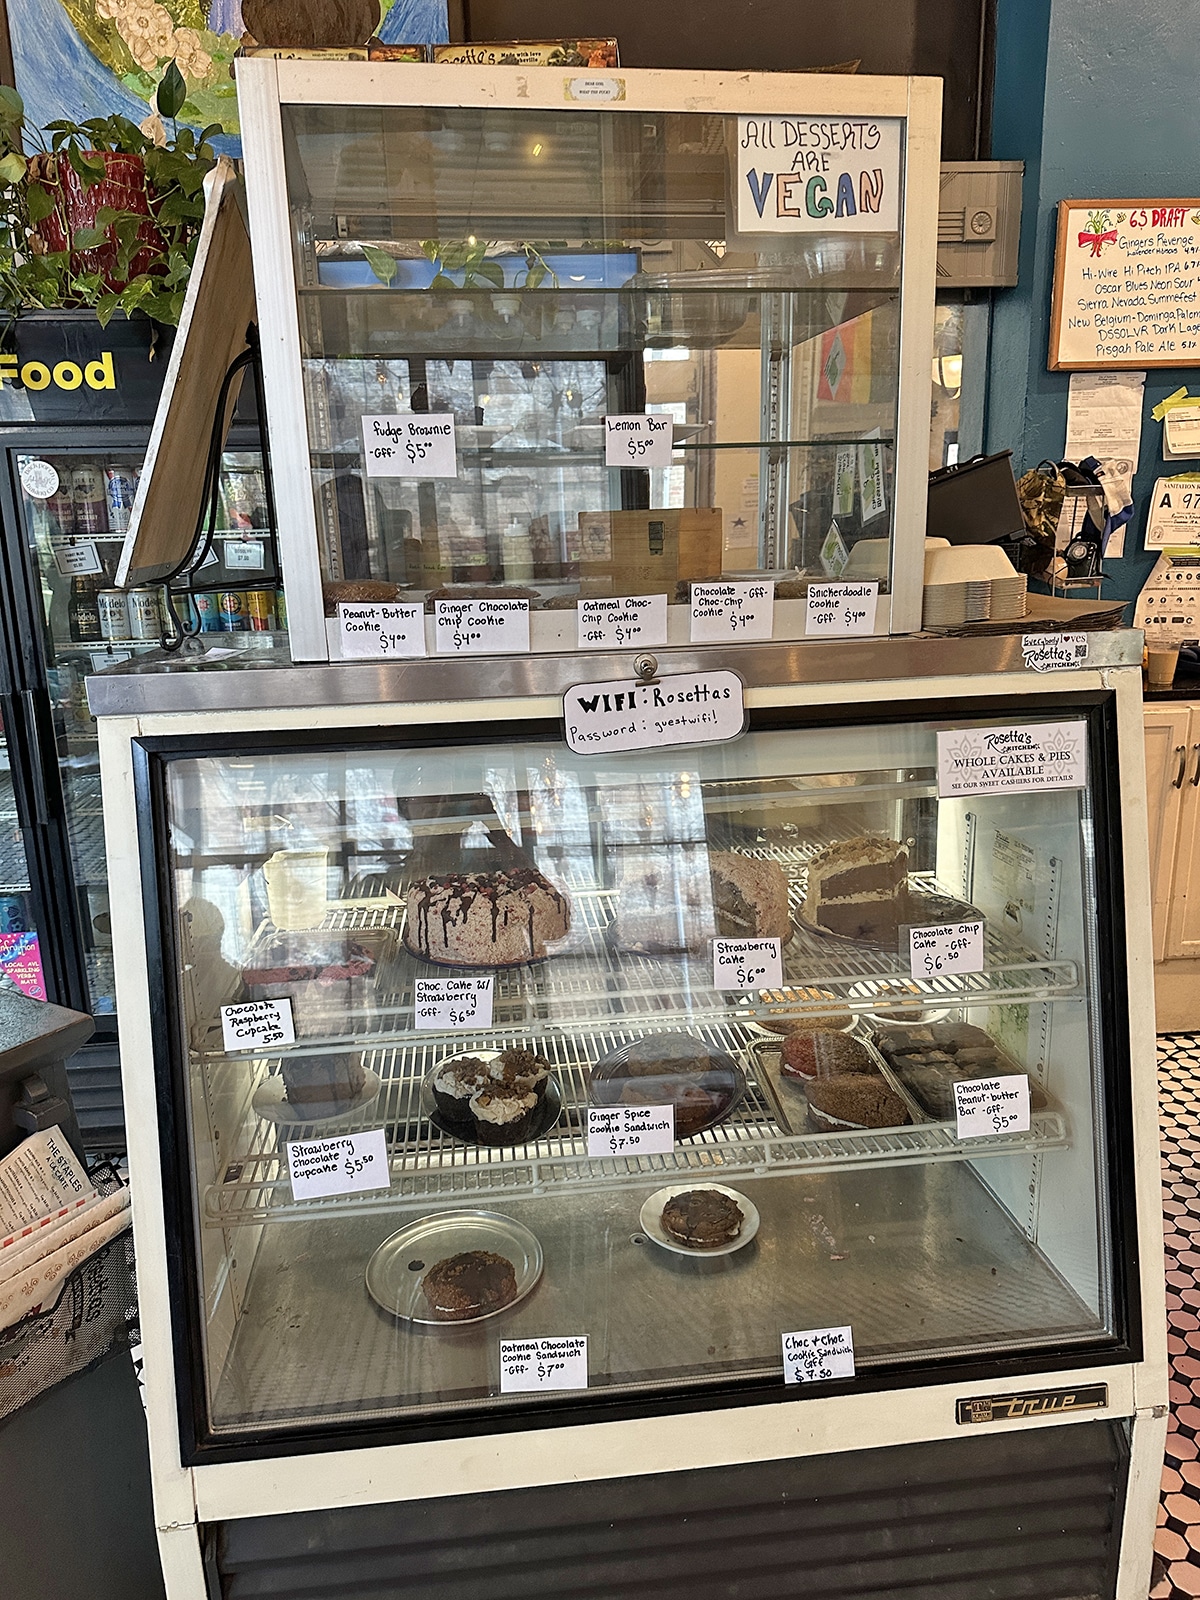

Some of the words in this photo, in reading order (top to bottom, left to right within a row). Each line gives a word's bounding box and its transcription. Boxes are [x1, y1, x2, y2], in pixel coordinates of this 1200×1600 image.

[781, 120, 882, 150] DESSERTS
[790, 150, 831, 172] ARE
[746, 168, 884, 219] VEGAN
[1118, 236, 1154, 251] Gingers
[1157, 233, 1194, 248] Revenge
[1082, 267, 1118, 280] Hi-Wire
[1124, 266, 1134, 276] Hi
[1137, 264, 1162, 276] Pitch
[1165, 262, 1181, 274] IPA
[1095, 283, 1122, 295] Oscar
[1126, 280, 1148, 292] Blues
[1150, 280, 1173, 290] Neon
[1174, 278, 1195, 289] Sour
[1078, 298, 1109, 311] Sierra
[1112, 296, 1147, 309] Nevada
[1068, 316, 1091, 329] New
[1098, 326, 1149, 342] DSSOLVR
[1152, 323, 1177, 335] Dark
[1096, 344, 1132, 358] Pisgah
[1135, 340, 1154, 353] Pale
[1158, 340, 1176, 352] Ale
[408, 423, 452, 436] Brownie
[608, 420, 641, 432] Lemon
[648, 418, 667, 431] Bar
[1159, 493, 1172, 508] A
[694, 586, 736, 597] Chocolate
[809, 586, 872, 598] Snickerdoodle
[440, 602, 473, 618] Ginger
[479, 600, 529, 612] Chocolate
[584, 600, 622, 611] Oatmeal
[625, 599, 652, 609] Choc-
[698, 597, 744, 608] Choc-Chip
[343, 608, 417, 619] Peanut-Butter
[582, 614, 602, 624] Chip
[608, 612, 638, 622] Cookie
[693, 608, 723, 618] Cookie
[345, 622, 381, 632] Cookie
[1024, 636, 1060, 650] Everybody
[1024, 647, 1072, 670] Rosetta's
[653, 684, 730, 707] Rosettas
[655, 710, 718, 732] guestwifi!
[984, 730, 1032, 753] Rosetta's
[954, 756, 996, 768] WHOLE
[999, 754, 1035, 765] CAKES
[1038, 753, 1046, 762] &
[1048, 752, 1071, 761] PIES
[981, 766, 1044, 779] AVAILABLE
[1001, 778, 1031, 786] CASHIERS
[912, 927, 953, 940] Chocolate
[958, 924, 980, 936] Chip
[717, 942, 777, 959] Strawberry
[913, 939, 937, 949] Cake
[718, 955, 745, 965] Cake
[446, 980, 472, 990] Cake
[416, 992, 477, 1008] Strawberry
[230, 1012, 281, 1028] Raspberry
[236, 1024, 281, 1039] Cupcake
[956, 1082, 1001, 1094] Chocolate
[589, 1110, 621, 1125] Ginger
[627, 1109, 651, 1122] Spice
[958, 1106, 976, 1116] Bar
[624, 1120, 670, 1133] Sandwich
[292, 1138, 355, 1159] Strawberry
[46, 1138, 61, 1157] THE
[56, 1156, 83, 1193] STAPLES
[54, 1170, 70, 1191] CARTE
[501, 1343, 540, 1354] Oatmeal
[541, 1339, 585, 1350] Chocolate
[785, 1336, 810, 1349] Choc
[821, 1334, 845, 1346] Choc
[502, 1354, 532, 1363] Cookie
[536, 1349, 581, 1360] Sandwich
[788, 1350, 816, 1362] Cookie
[817, 1346, 854, 1358] Sandwich
